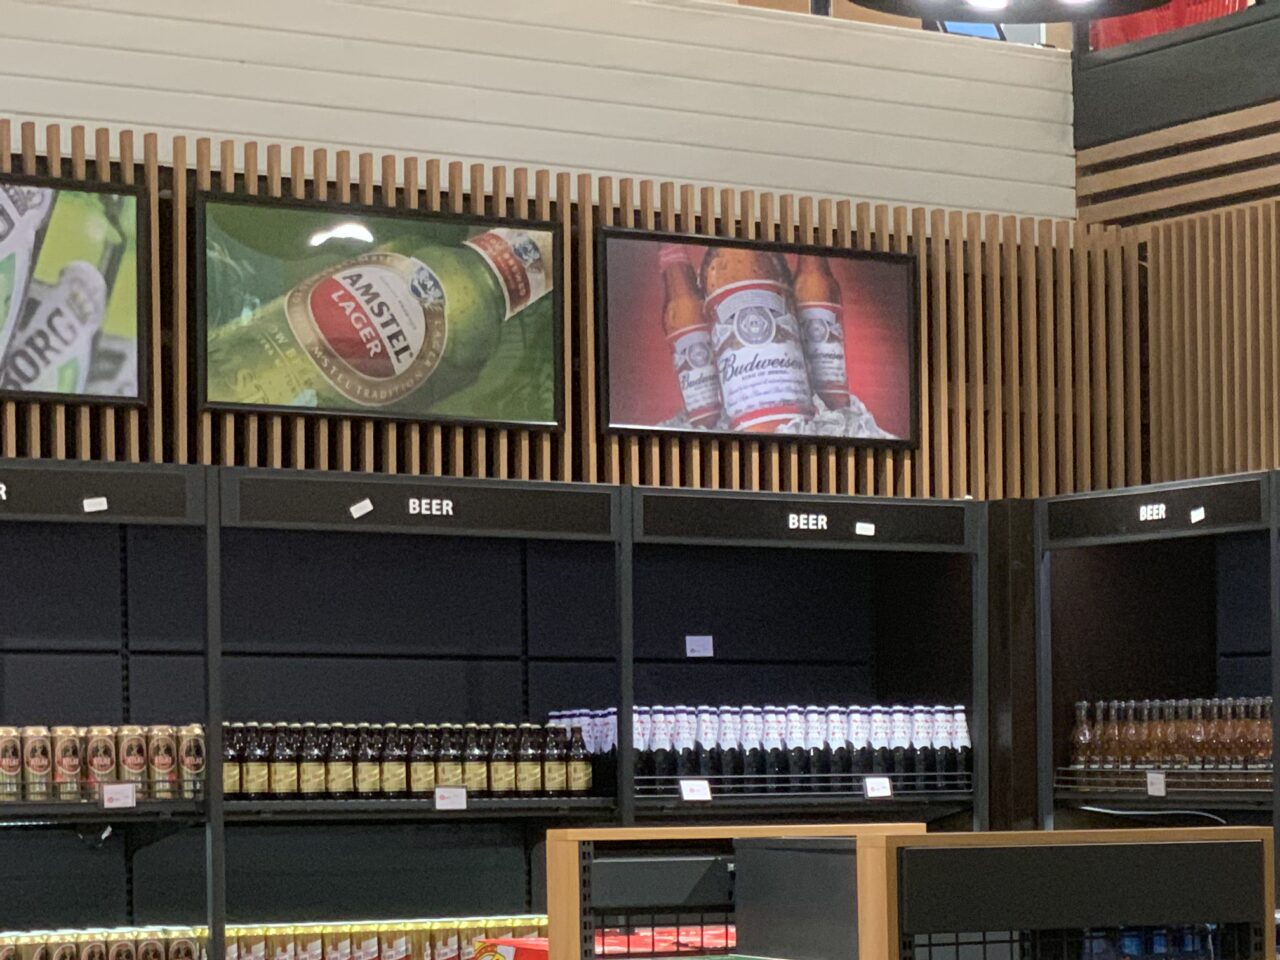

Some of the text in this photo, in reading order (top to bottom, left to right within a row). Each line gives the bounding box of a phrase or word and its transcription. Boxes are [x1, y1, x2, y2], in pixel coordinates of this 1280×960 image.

[330, 289, 382, 358] LAGER
[341, 272, 412, 364] AMSTEL
[408, 497, 455, 517] BEER
[1139, 503, 1167, 522] BEER
[788, 513, 829, 531] BEER
